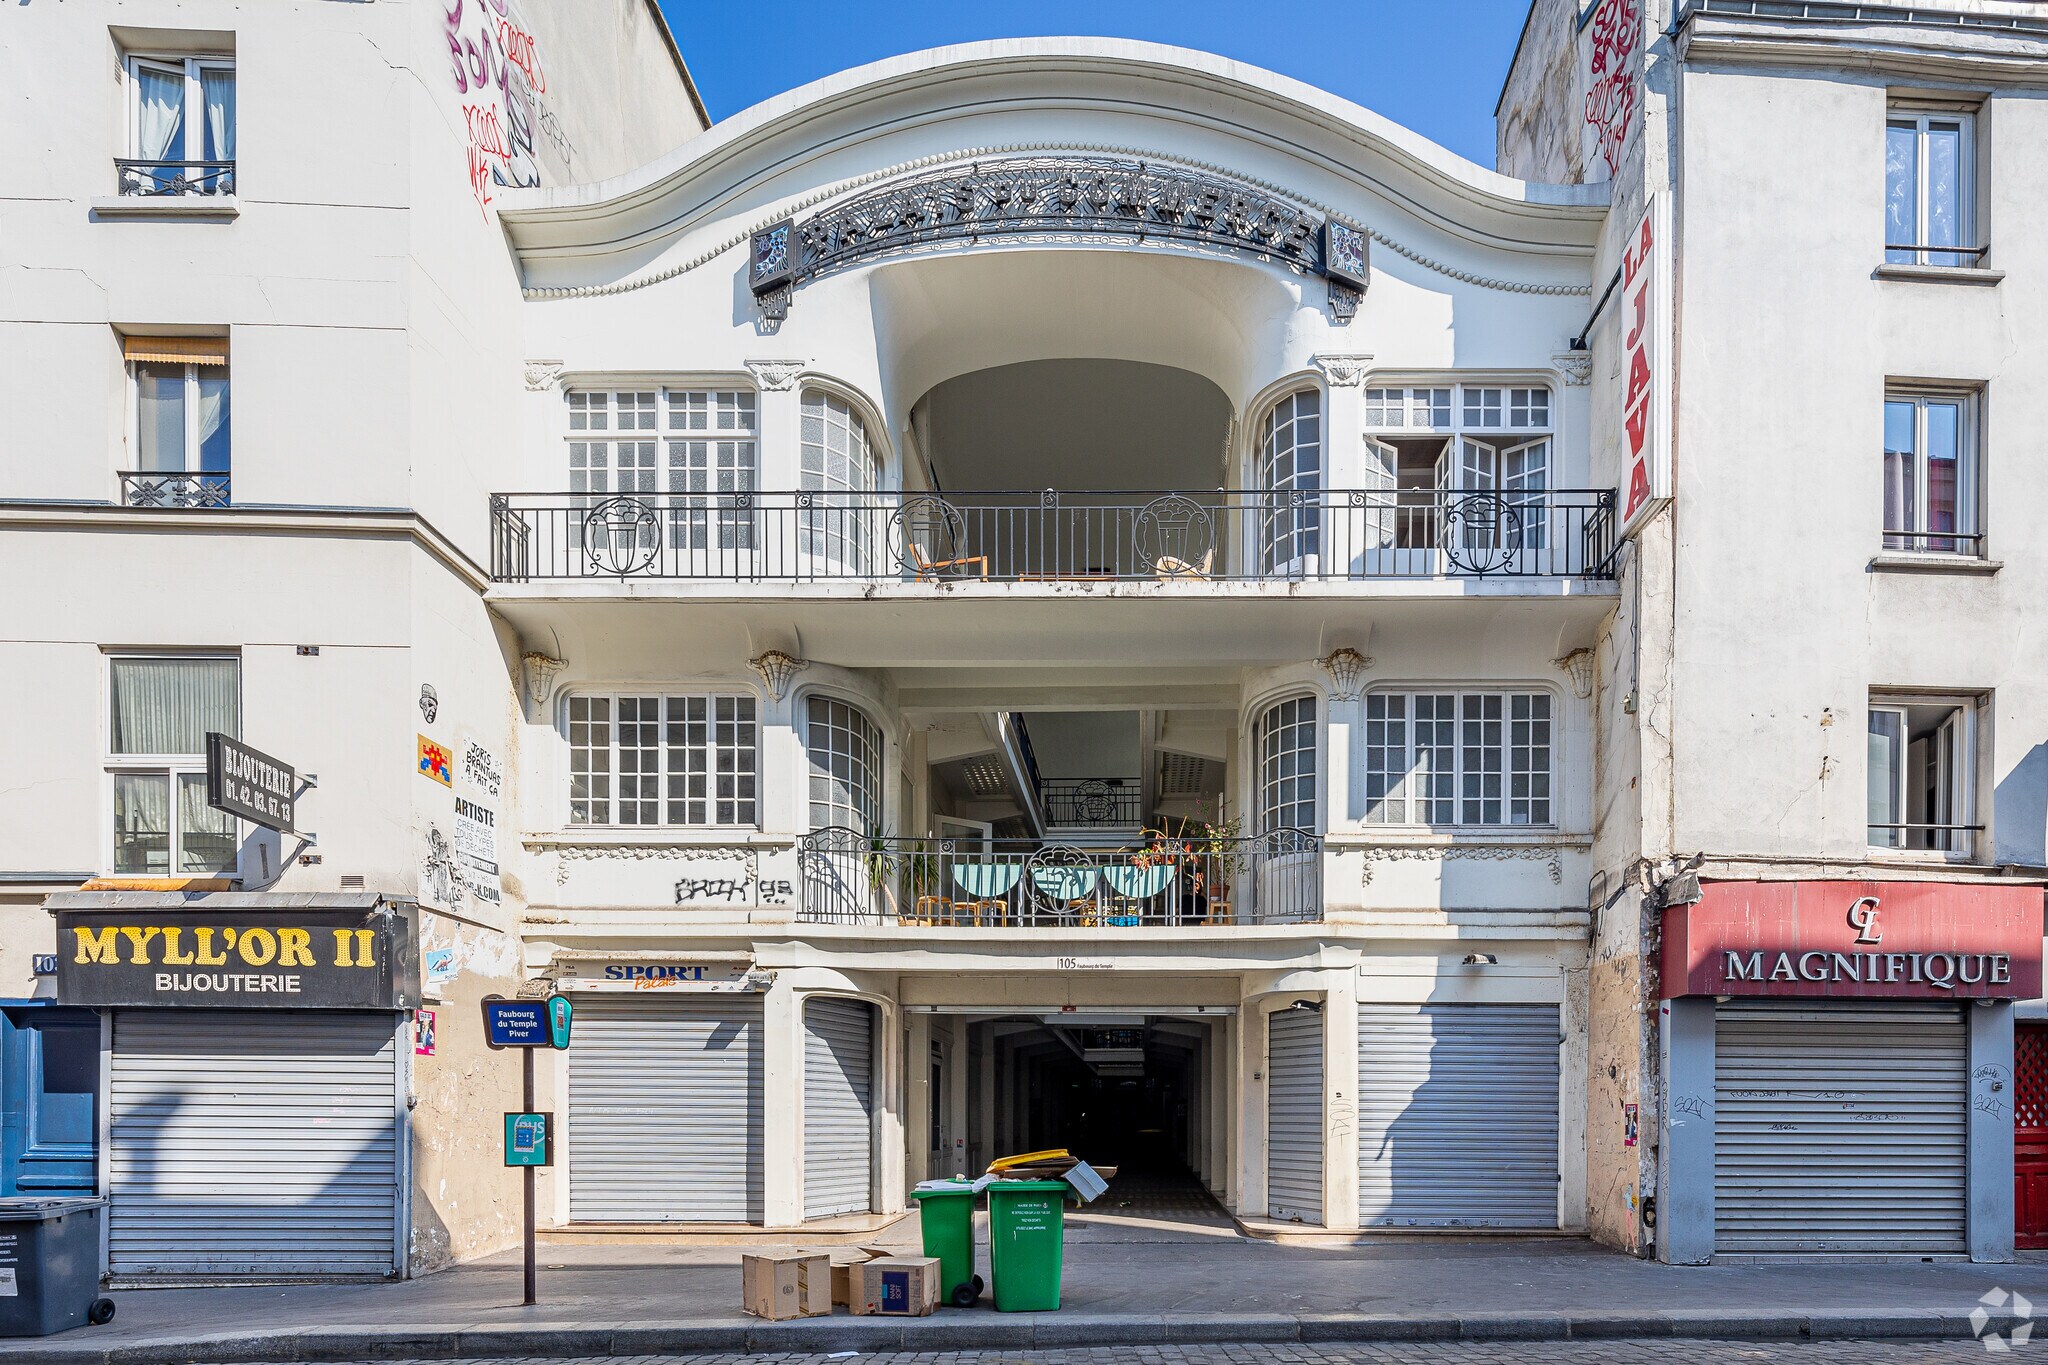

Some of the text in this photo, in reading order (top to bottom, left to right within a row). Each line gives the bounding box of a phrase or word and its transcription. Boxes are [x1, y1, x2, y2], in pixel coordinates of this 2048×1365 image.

[806, 172, 1313, 250] PALAIS DU COMMERCE
[1623, 216, 1653, 292] LA
[1624, 277, 1651, 524] JAVA
[224, 745, 291, 799] BIJOUTERIE
[455, 797, 494, 828] ARTISTE
[74, 926, 377, 967] MYLL'OR II
[36, 956, 58, 972] 10
[605, 965, 709, 981] SPORT
[1060, 957, 1076, 969] 105
[1725, 950, 2011, 989] MAGNIFIQUE
[155, 973, 301, 993] BIJOUTERIE
[634, 974, 677, 990] Palais
[498, 1010, 535, 1019] Faubourg
[498, 1020, 538, 1029] du Temple
